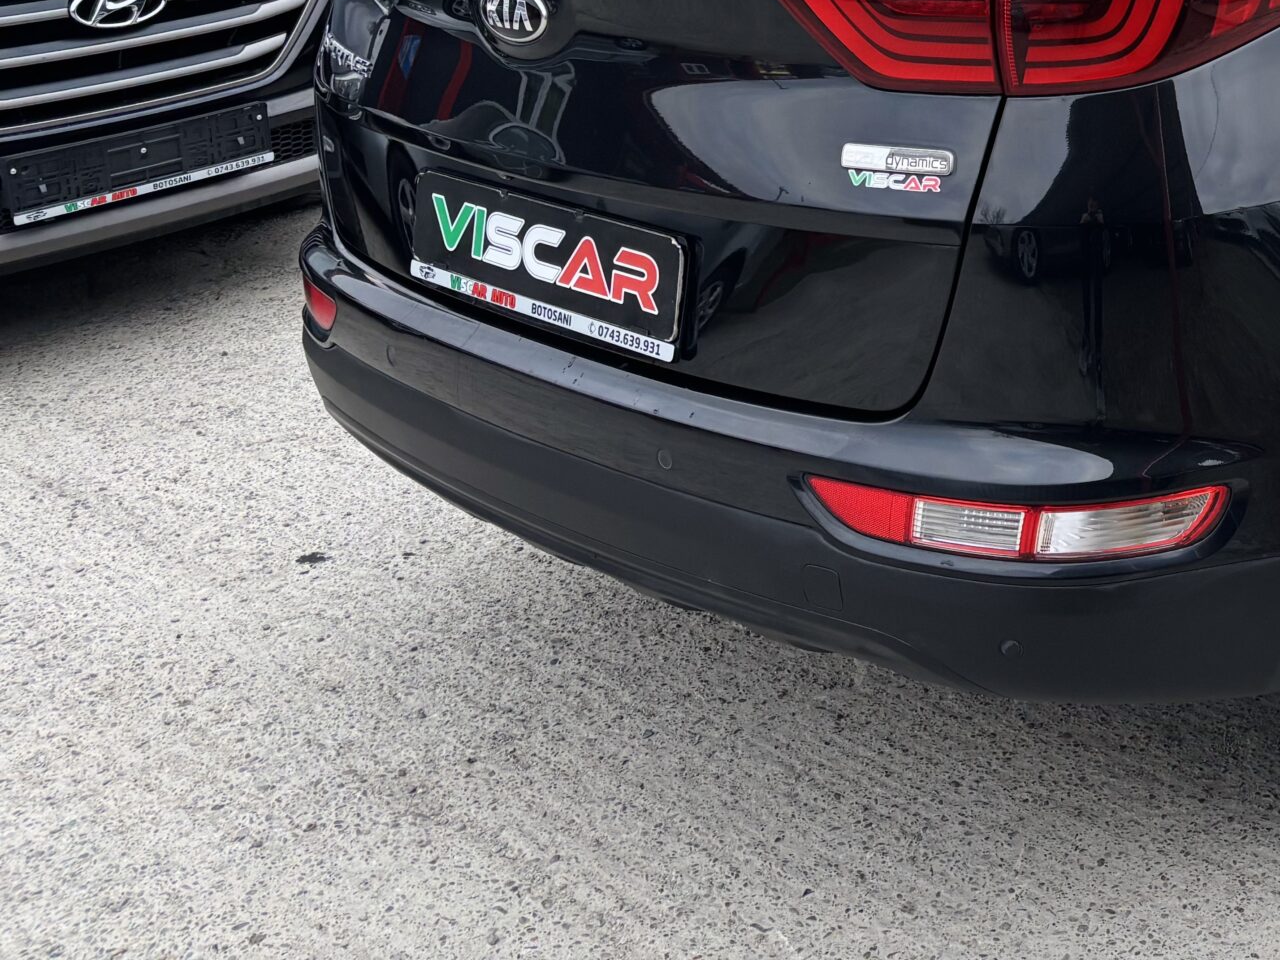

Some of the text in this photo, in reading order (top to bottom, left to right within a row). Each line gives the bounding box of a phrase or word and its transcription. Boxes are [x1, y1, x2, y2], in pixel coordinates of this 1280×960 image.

[64, 155, 266, 214] VISCAR AUTO BOTOSANI 0743.639.931
[848, 169, 941, 192] VISCAR
[885, 152, 948, 170] dynamics
[431, 192, 660, 315] VISCAR
[450, 273, 661, 356] VISCAR AUTO BOTOSANI 0743.639.931
